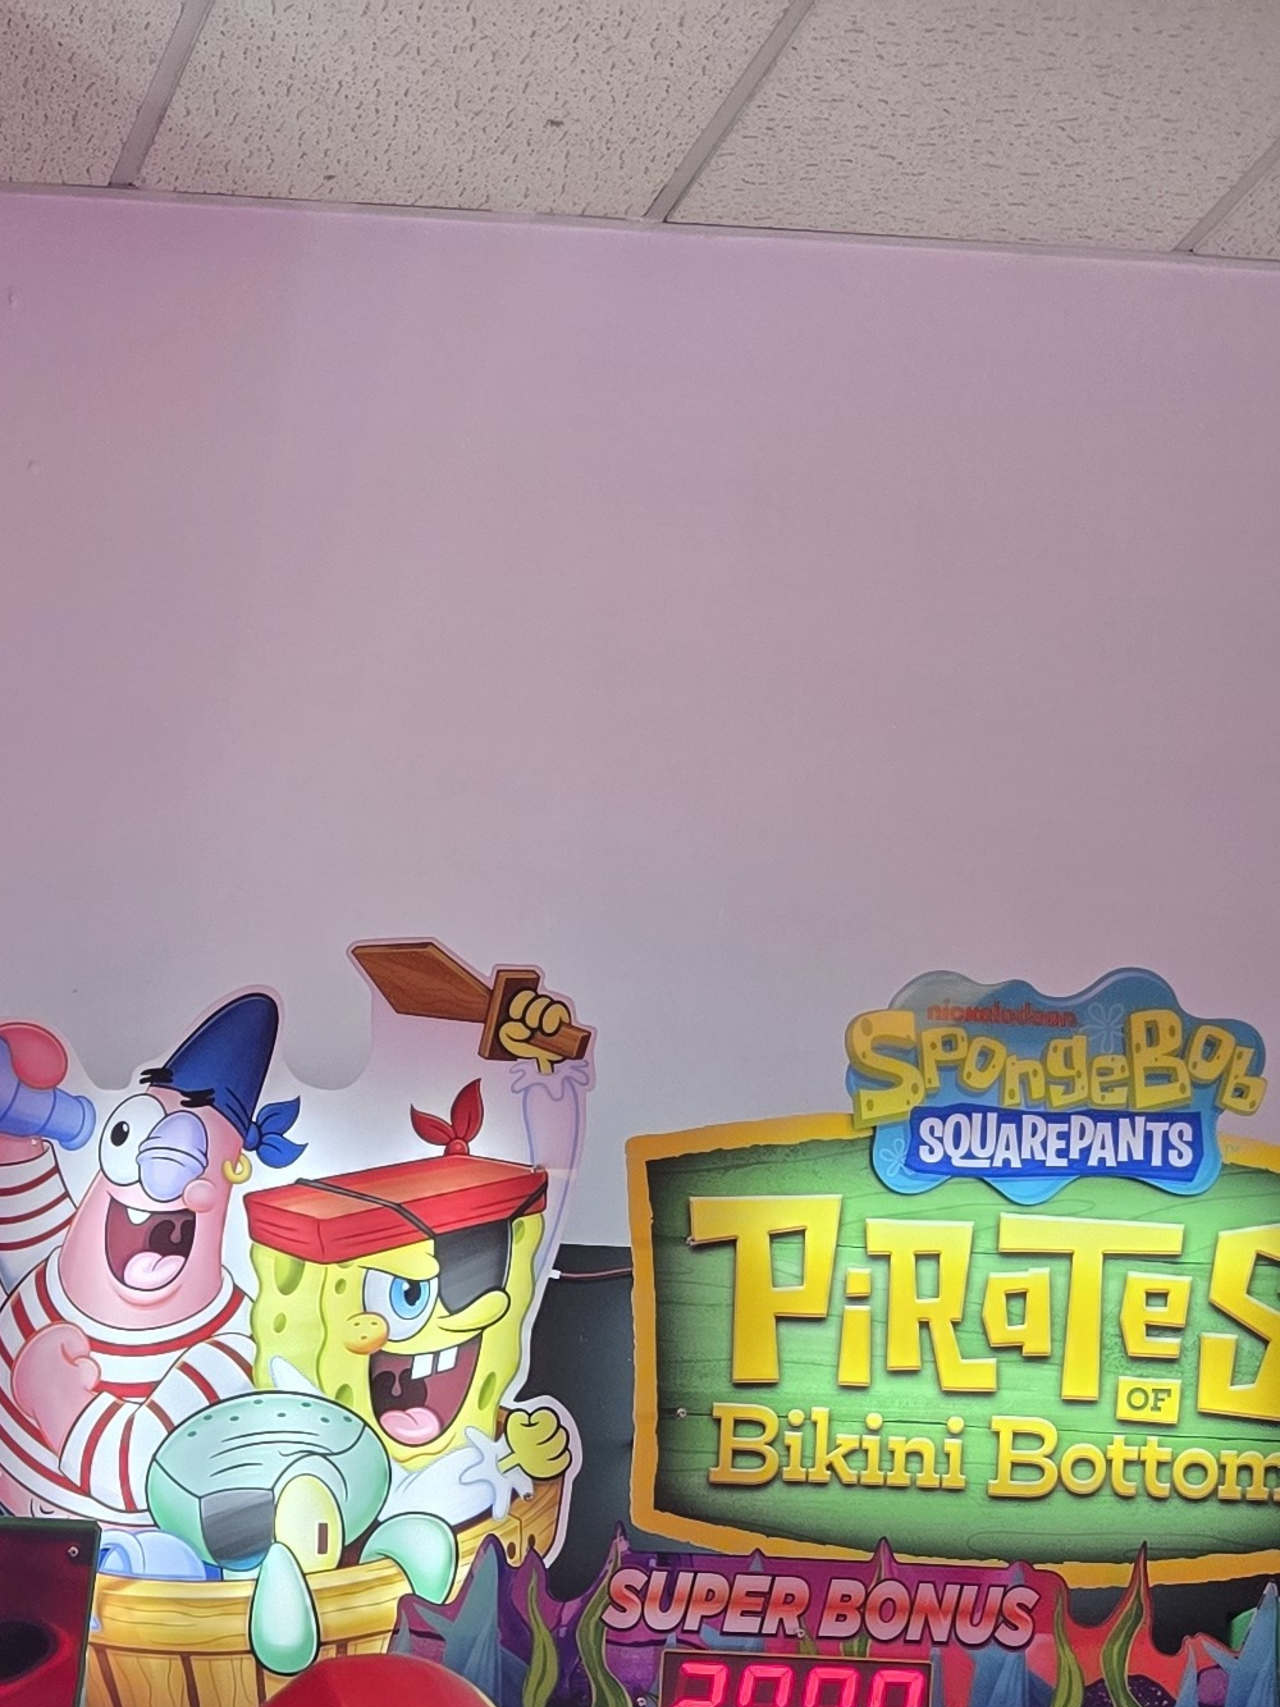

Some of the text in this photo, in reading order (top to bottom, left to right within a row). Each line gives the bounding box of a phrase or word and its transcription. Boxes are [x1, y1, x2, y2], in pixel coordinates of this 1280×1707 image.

[918, 1112, 1193, 1168] SQUAREPANTS
[1127, 1388, 1171, 1413] OF
[710, 1402, 1280, 1500] Bikini Bottom
[600, 1567, 1040, 1650] SUPER BONUS
